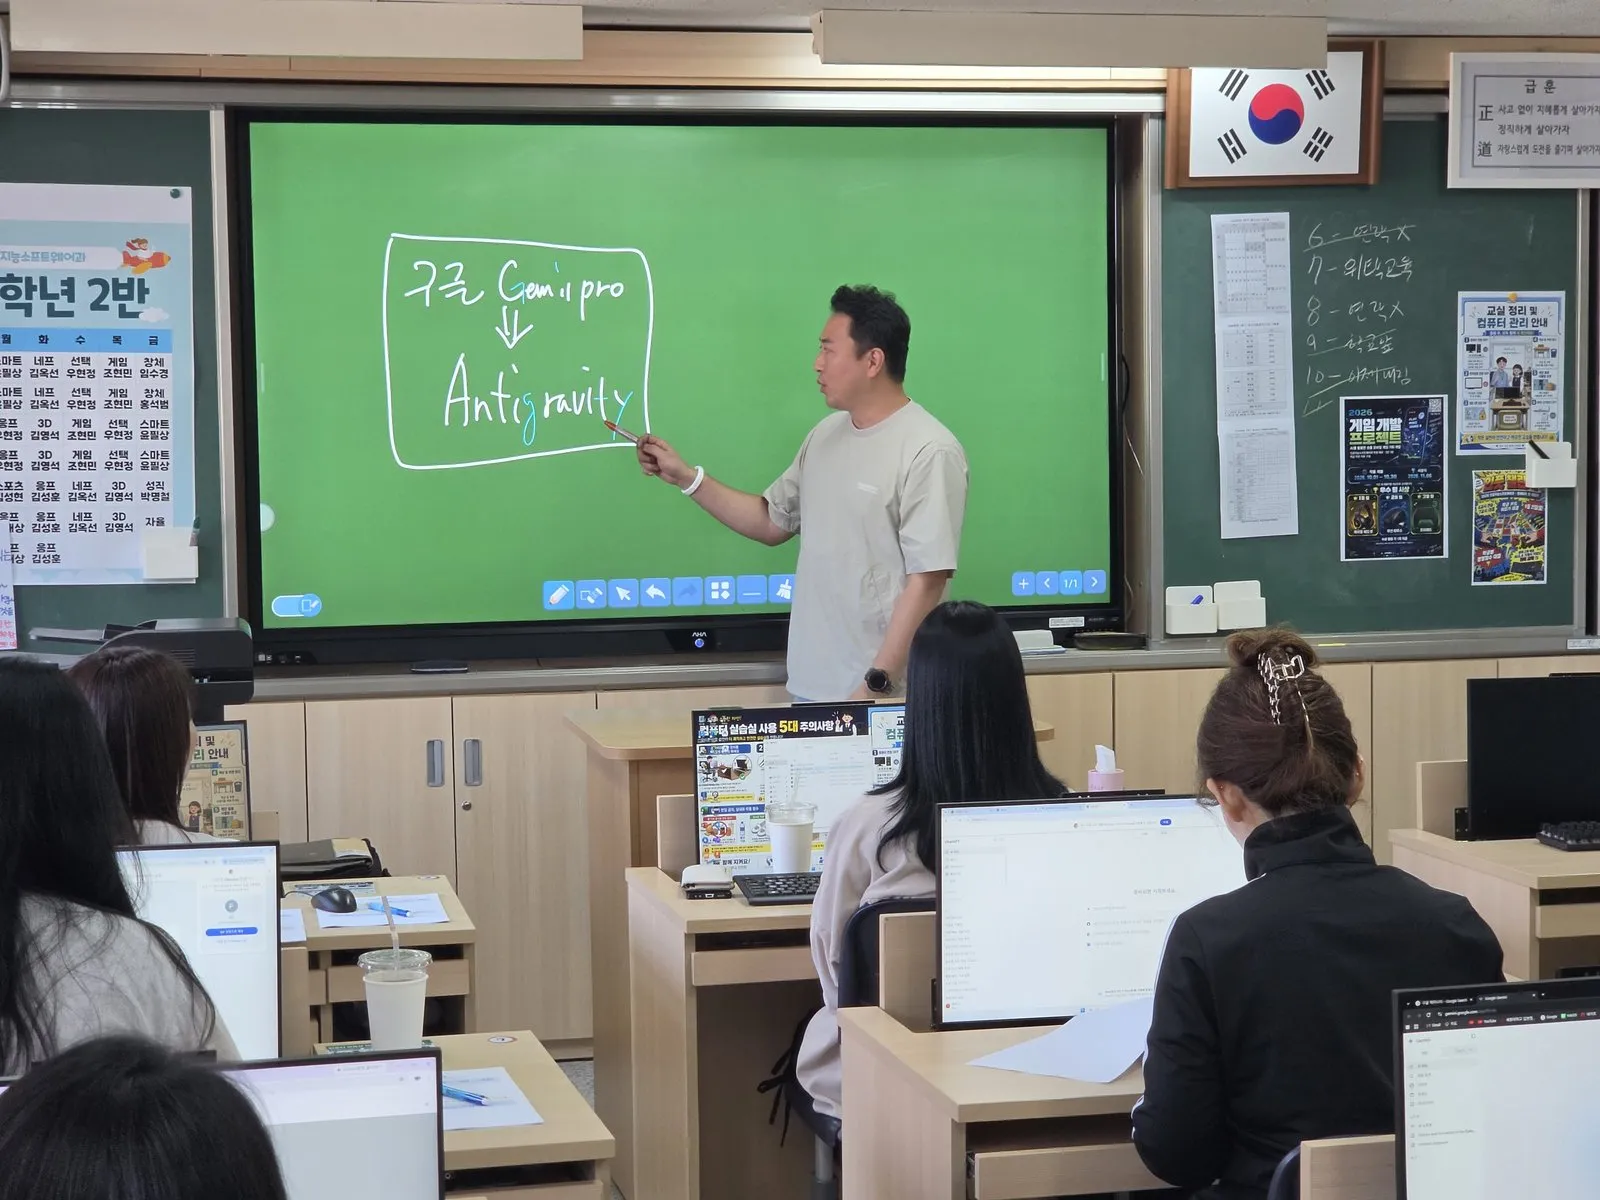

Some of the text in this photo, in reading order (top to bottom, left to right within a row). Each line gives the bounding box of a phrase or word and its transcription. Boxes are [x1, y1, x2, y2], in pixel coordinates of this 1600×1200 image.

[1524, 80, 1556, 94] 급 훈
[1478, 104, 1494, 157] 正 道
[1498, 124, 1571, 136] 정직하게 살아가자
[0, 272, 150, 320] 학년 2반
[405, 260, 485, 308] 구글
[580, 279, 624, 322] pro
[1487, 306, 1538, 316] 교실 정리 및
[1478, 318, 1548, 328] 컴퓨터 관리 안내
[38, 334, 49, 345] 화
[75, 334, 86, 346] 수
[112, 336, 122, 346] 목
[148, 336, 159, 346] 금
[34, 356, 54, 366] 네프
[71, 356, 91, 366] 선택
[108, 357, 128, 367] 게임
[144, 357, 164, 368] 창체
[30, 368, 59, 378] 김옥선
[66, 368, 96, 379] 우현정
[104, 368, 132, 378] 조현민
[140, 368, 168, 379] 임수경
[34, 387, 55, 398] 네프
[72, 388, 92, 398] 선택
[108, 388, 128, 398] 게임
[144, 388, 164, 398] 창체
[444, 352, 634, 446] Antigravity
[67, 400, 96, 410] 우현정
[104, 400, 132, 410] 조현민
[140, 400, 169, 410] 홍석범
[38, 418, 52, 428] 3D
[72, 418, 92, 428] 게임
[108, 420, 128, 429] 선택
[140, 420, 170, 429] 스마트
[30, 430, 60, 440] 김영석
[67, 430, 96, 440] 조현민
[104, 430, 132, 440] 우현정
[140, 430, 170, 440] 윤필상
[1350, 432, 1402, 445] 프로젝트
[38, 450, 53, 460] 3D
[72, 450, 92, 460] 게임
[109, 450, 128, 460] 선택
[140, 450, 170, 460] 스마트
[31, 462, 60, 471] 김영석
[68, 462, 96, 470] 조현민
[104, 461, 133, 471] 우현정
[140, 461, 170, 471] 윤필상
[72, 481, 92, 491] 네프
[112, 482, 126, 490] 3D
[146, 481, 164, 490] 성직
[31, 492, 60, 502] 김성훈
[104, 492, 133, 502] 김영석
[72, 512, 93, 522] 네프
[112, 512, 126, 521] 3D
[146, 516, 165, 526] 자율
[32, 523, 61, 533] 김성훈
[105, 523, 134, 532] 김영석
[32, 554, 61, 564] 김성훈
[1064, 579, 1078, 588] 1/1
[730, 723, 756, 735] 실습실
[758, 722, 777, 734] 사용
[780, 720, 798, 733] 5대
[800, 720, 834, 732] 주의사항
[208, 748, 228, 760] 안내
